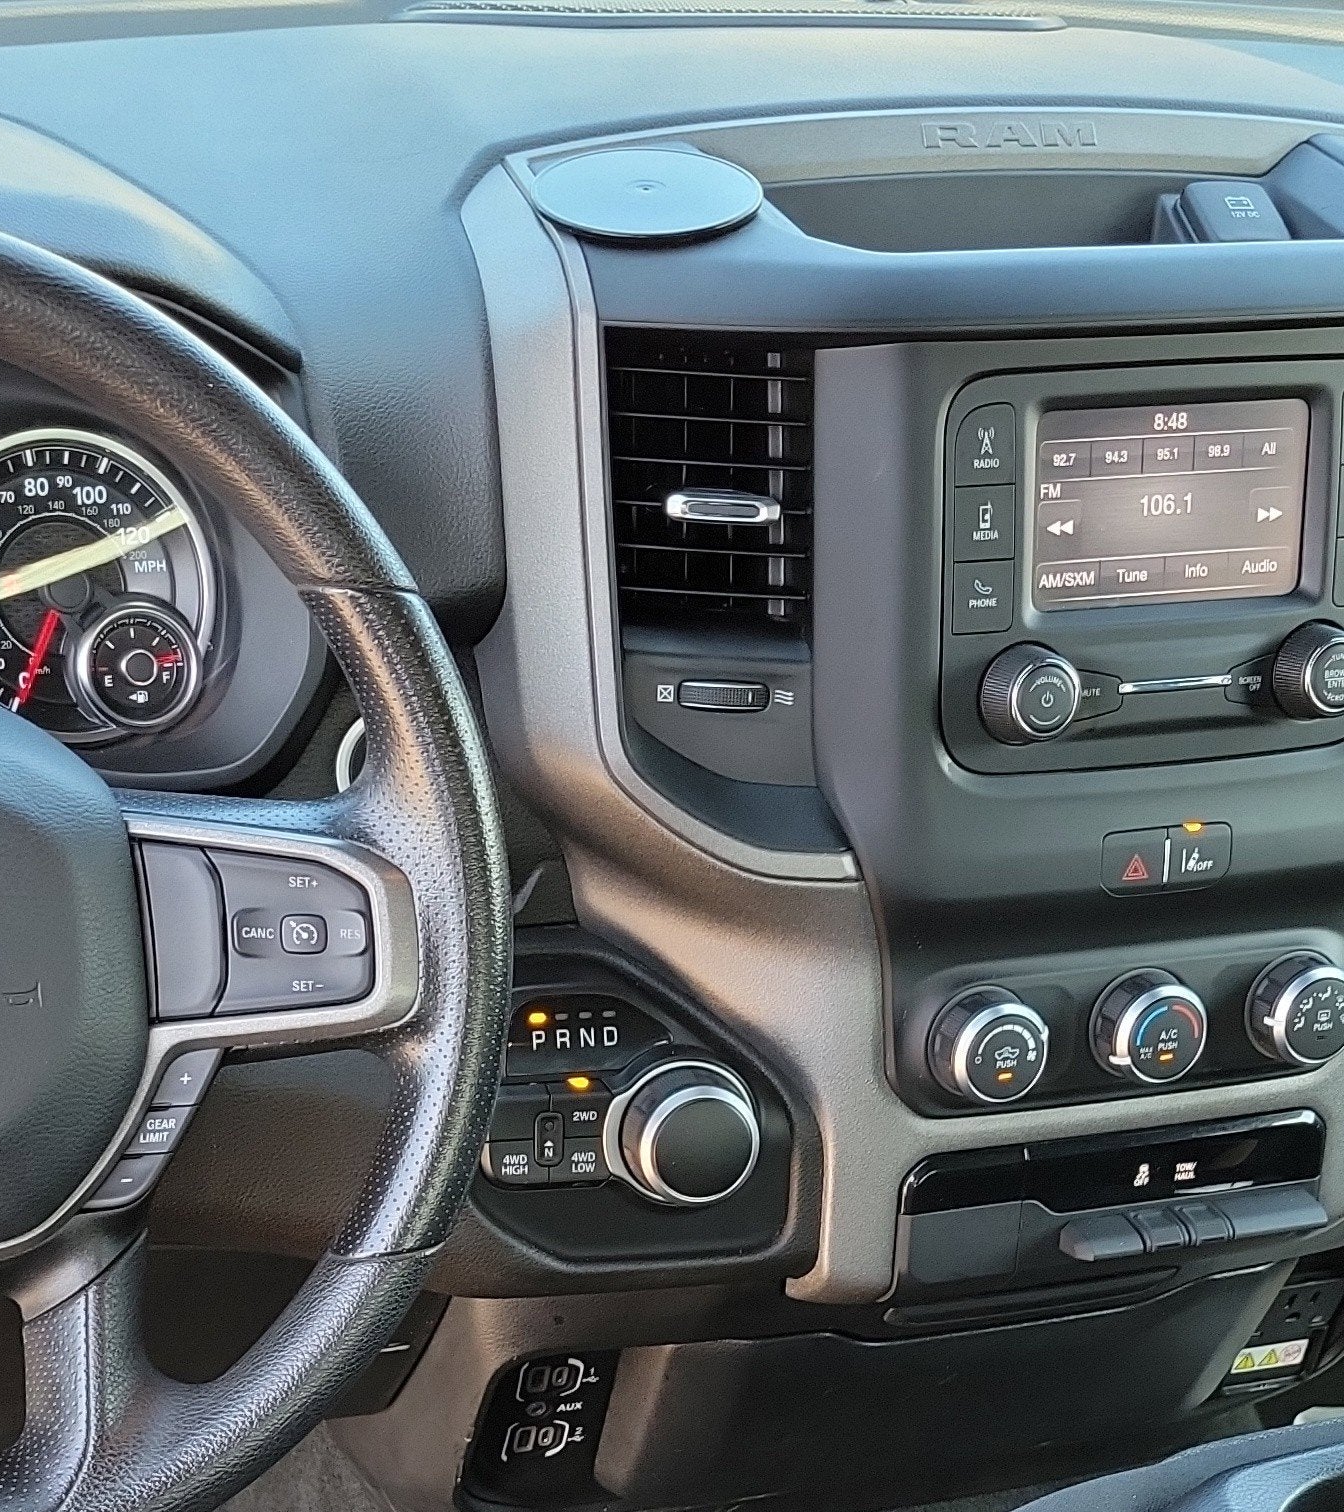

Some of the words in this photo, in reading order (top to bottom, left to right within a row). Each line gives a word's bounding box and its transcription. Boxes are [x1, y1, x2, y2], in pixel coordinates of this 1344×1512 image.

[921, 121, 1097, 148] RAM
[1154, 412, 1188, 430] 8:48
[1157, 447, 1179, 460] 95.1
[1261, 442, 1277, 455] All
[1053, 453, 1076, 467] 92.7
[1105, 450, 1128, 463] 94.3
[973, 458, 999, 469] RADIO
[24, 478, 49, 496] 80
[56, 475, 72, 488] 90
[0, 491, 15, 504] 70
[72, 485, 107, 505] 100
[1040, 483, 1061, 500] FM
[17, 505, 35, 515] 120
[47, 501, 65, 510] 140
[110, 503, 132, 515] 110
[1140, 492, 1192, 517] 106.1
[81, 506, 98, 516] 160
[102, 518, 121, 528] 180
[117, 526, 150, 545] 120
[973, 529, 999, 541] MEDIA
[129, 551, 147, 561] 200
[134, 560, 167, 573] MPH
[1184, 564, 1208, 578] Info
[1241, 559, 1278, 574] Audio
[1038, 571, 1095, 589] AM/SXM
[1116, 568, 1148, 583] Tune
[969, 598, 997, 608] PHONE
[0, 640, 13, 650] 20
[104, 674, 114, 687] E
[162, 671, 171, 684] F
[1197, 860, 1213, 872] OFF
[288, 876, 318, 888] SET+
[242, 927, 275, 939] CANC
[340, 929, 361, 940] RES
[1313, 1021, 1333, 1032] PUSH
[532, 1030, 546, 1051] P
[556, 1029, 570, 1049] R
[579, 1027, 595, 1048] N
[603, 1026, 618, 1046] D
[1159, 1028, 1178, 1041] A/C
[1157, 1041, 1178, 1052] PUSH
[996, 1059, 1017, 1069] PUSH
[572, 1111, 597, 1122] 2WD
[146, 1118, 176, 1130] GEAR
[139, 1132, 169, 1144] LIMIT
[544, 1147, 553, 1158] N
[571, 1152, 596, 1163] 4WD
[502, 1154, 528, 1165] 4WD
[501, 1164, 528, 1175] HIGH
[571, 1162, 596, 1173] LOW
[556, 1401, 584, 1412] AUX
[575, 1426, 583, 1435] 2
